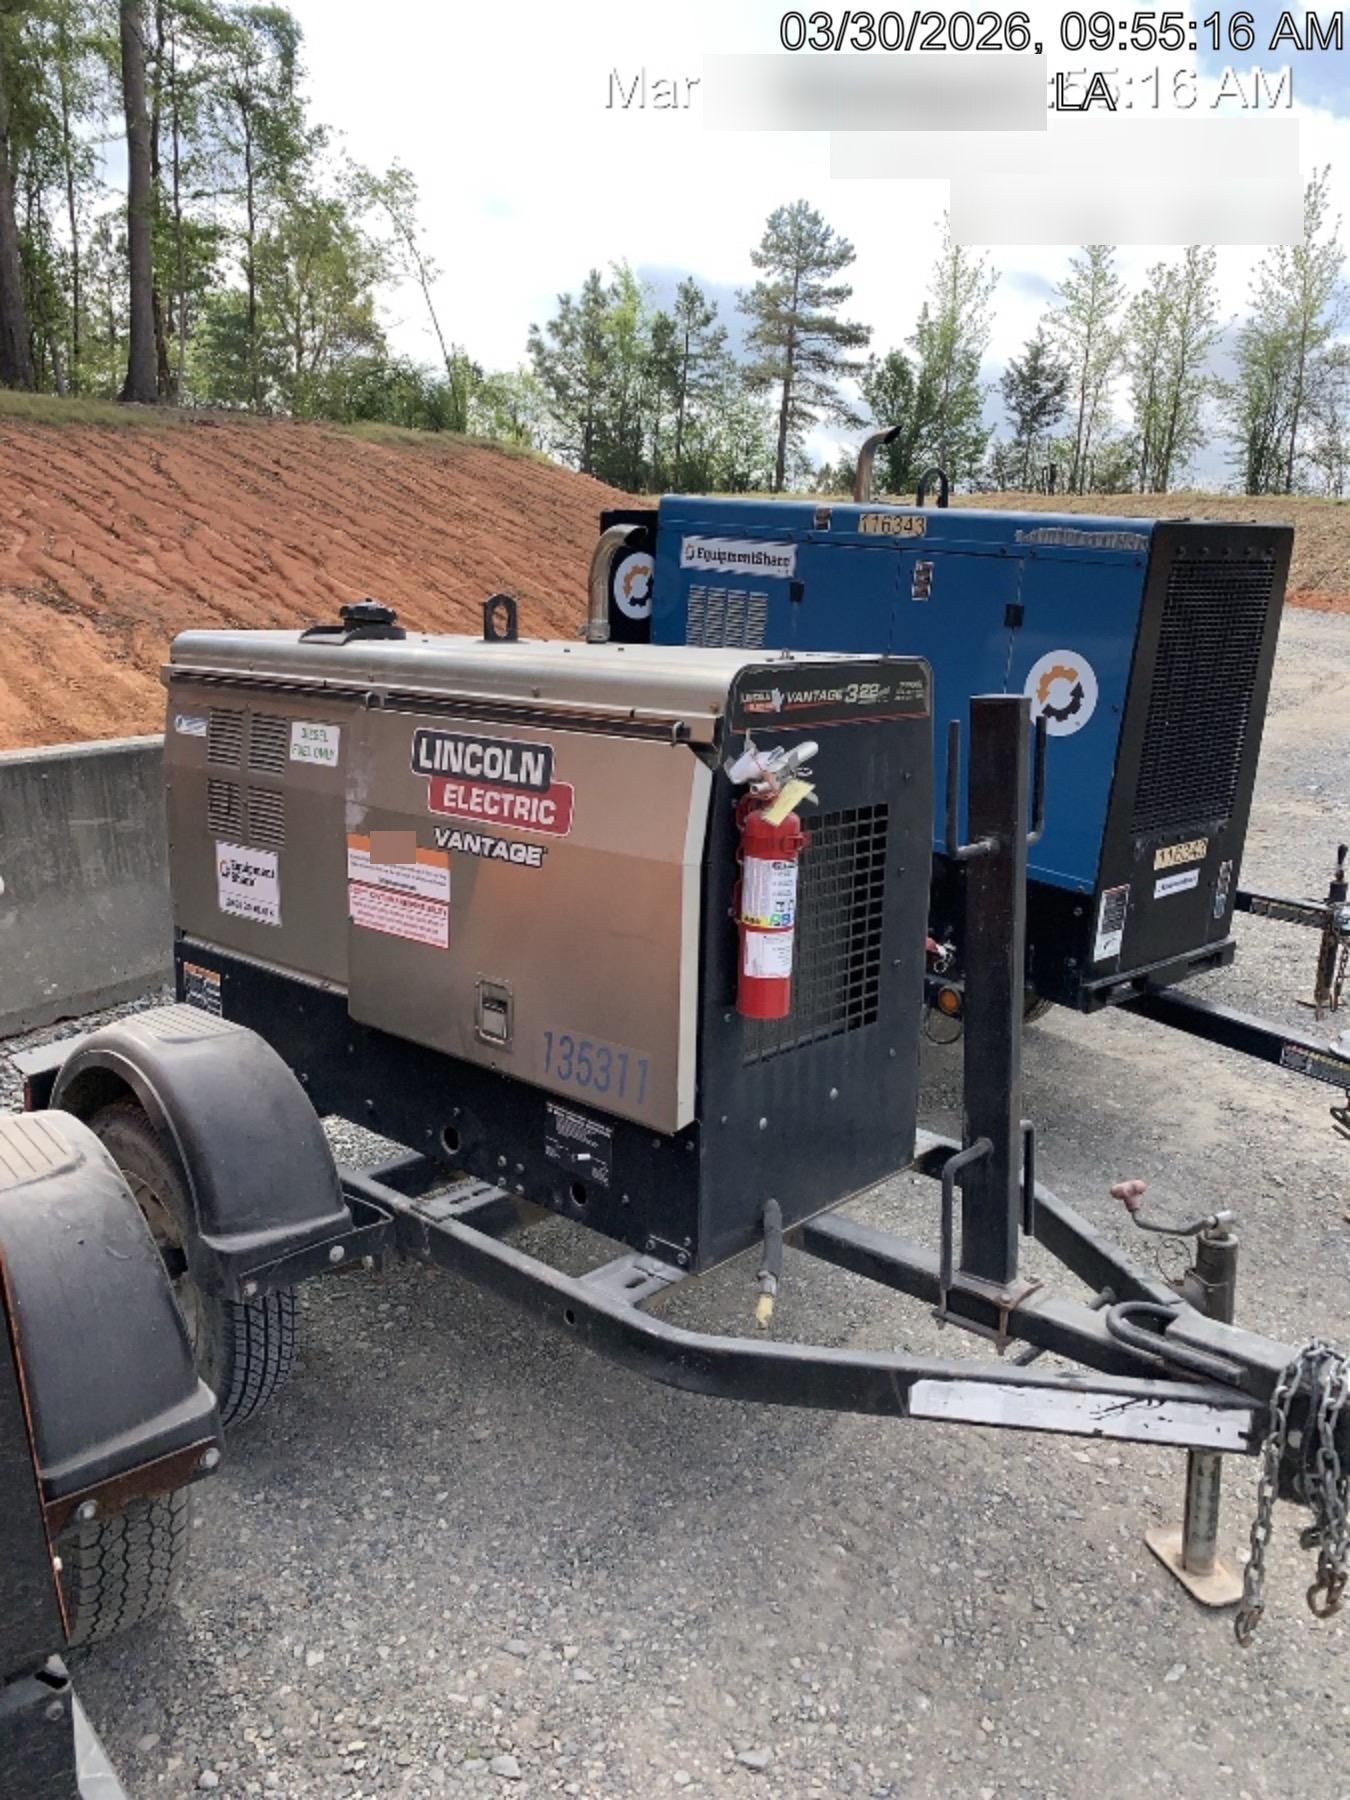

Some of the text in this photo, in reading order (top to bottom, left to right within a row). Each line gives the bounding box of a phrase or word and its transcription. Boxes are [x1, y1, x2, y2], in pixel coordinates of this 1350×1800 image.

[419, 737, 545, 786] LINCOLN
[443, 783, 557, 825] ELECTRIC
[434, 827, 544, 867] VANTAGE
[543, 1031, 649, 1104] 135311
